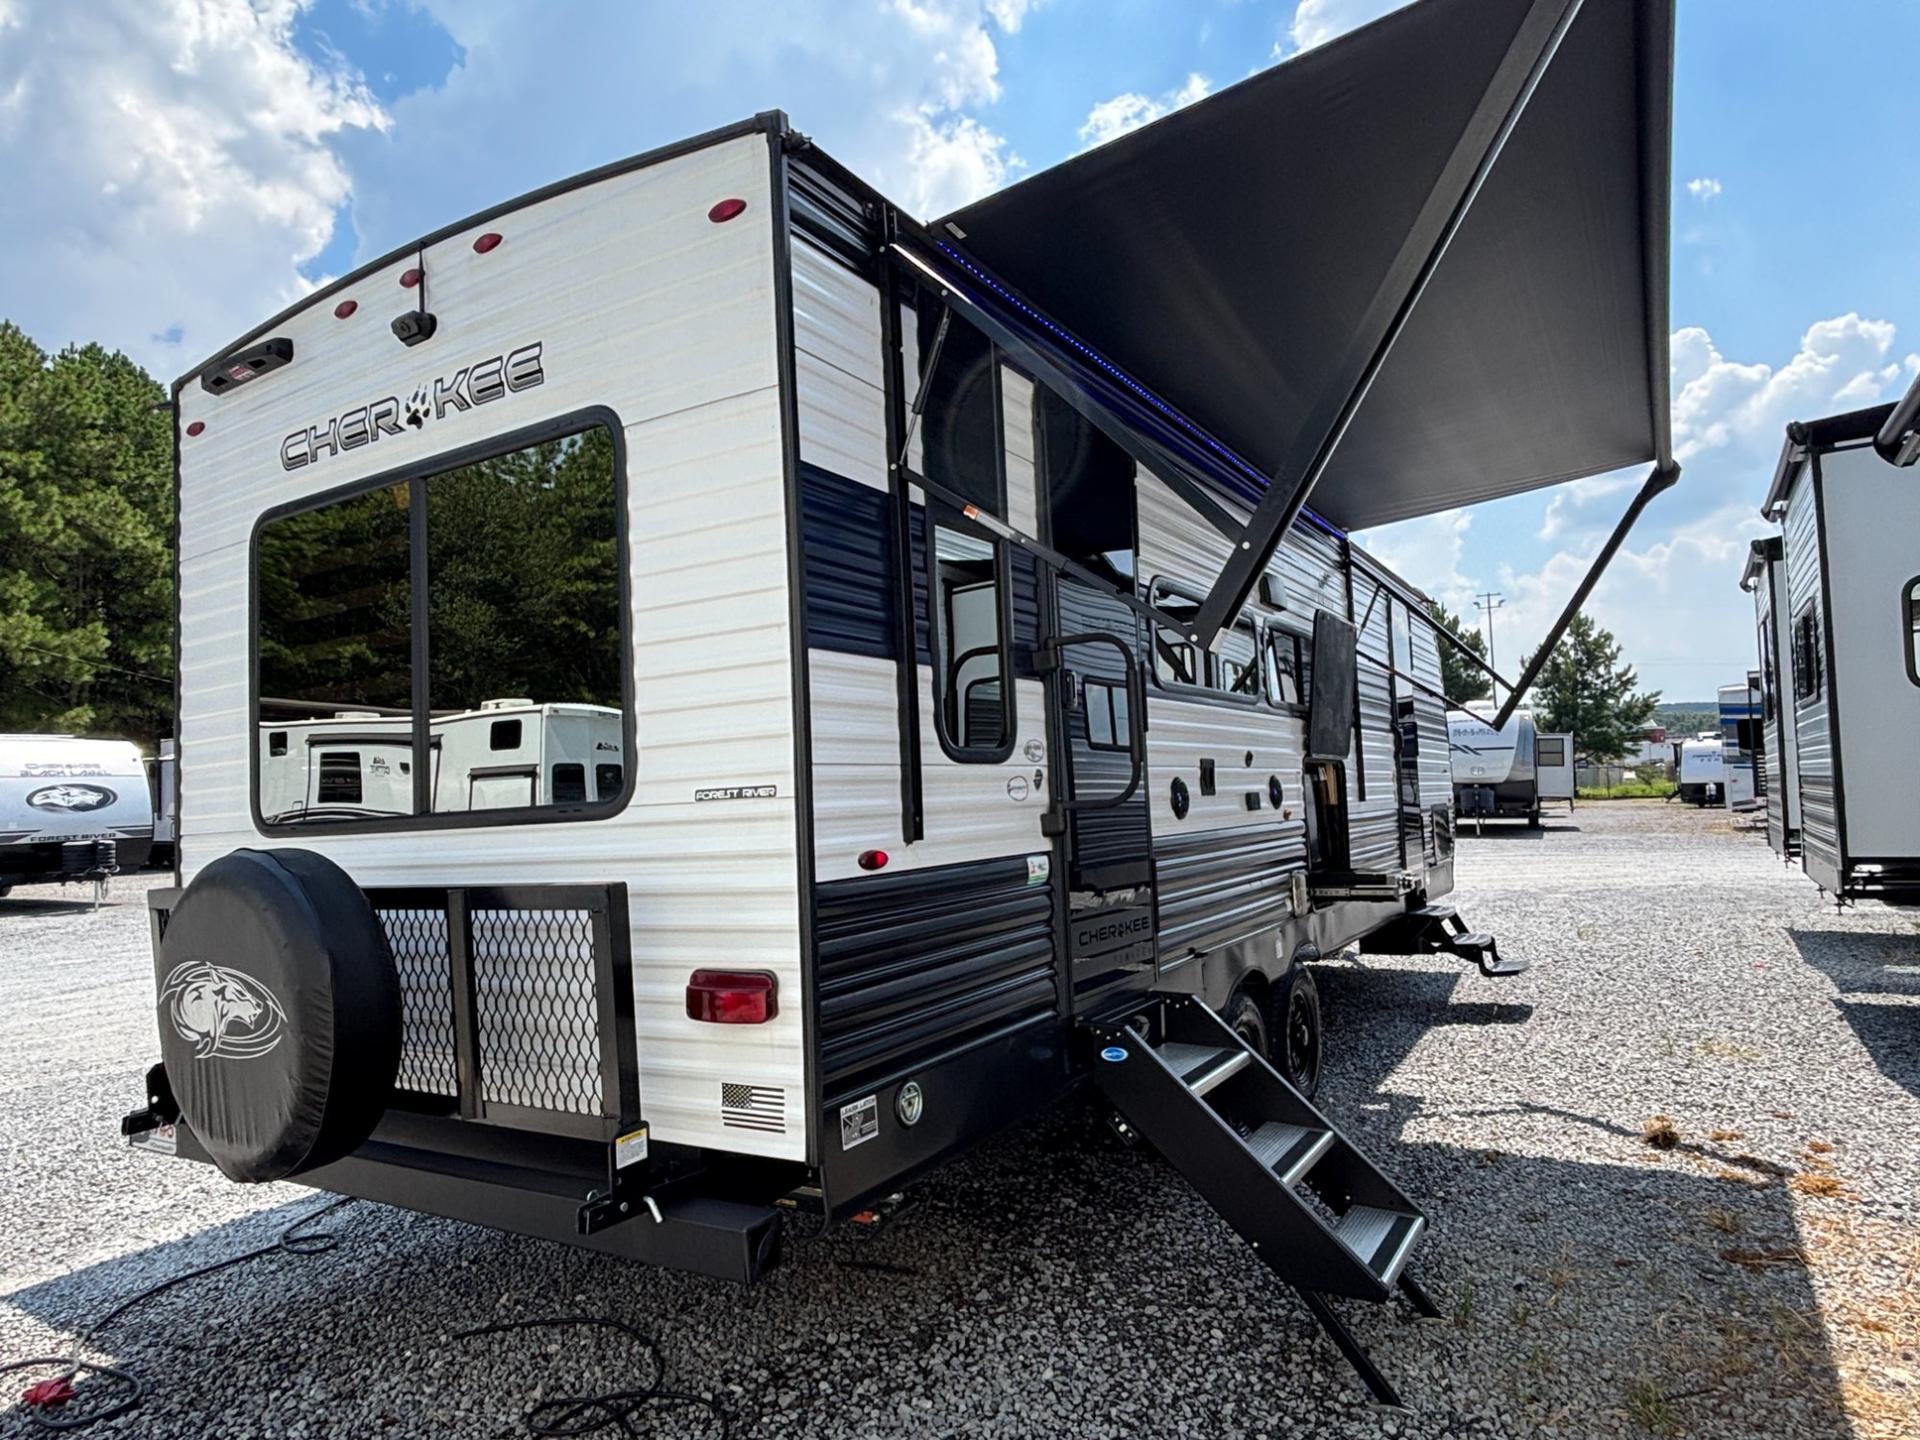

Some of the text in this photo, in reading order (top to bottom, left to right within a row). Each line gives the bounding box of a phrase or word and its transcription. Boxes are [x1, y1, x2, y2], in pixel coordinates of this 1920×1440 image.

[695, 786, 776, 801] FOREST RIVER
[81, 832, 116, 840] RIVER
